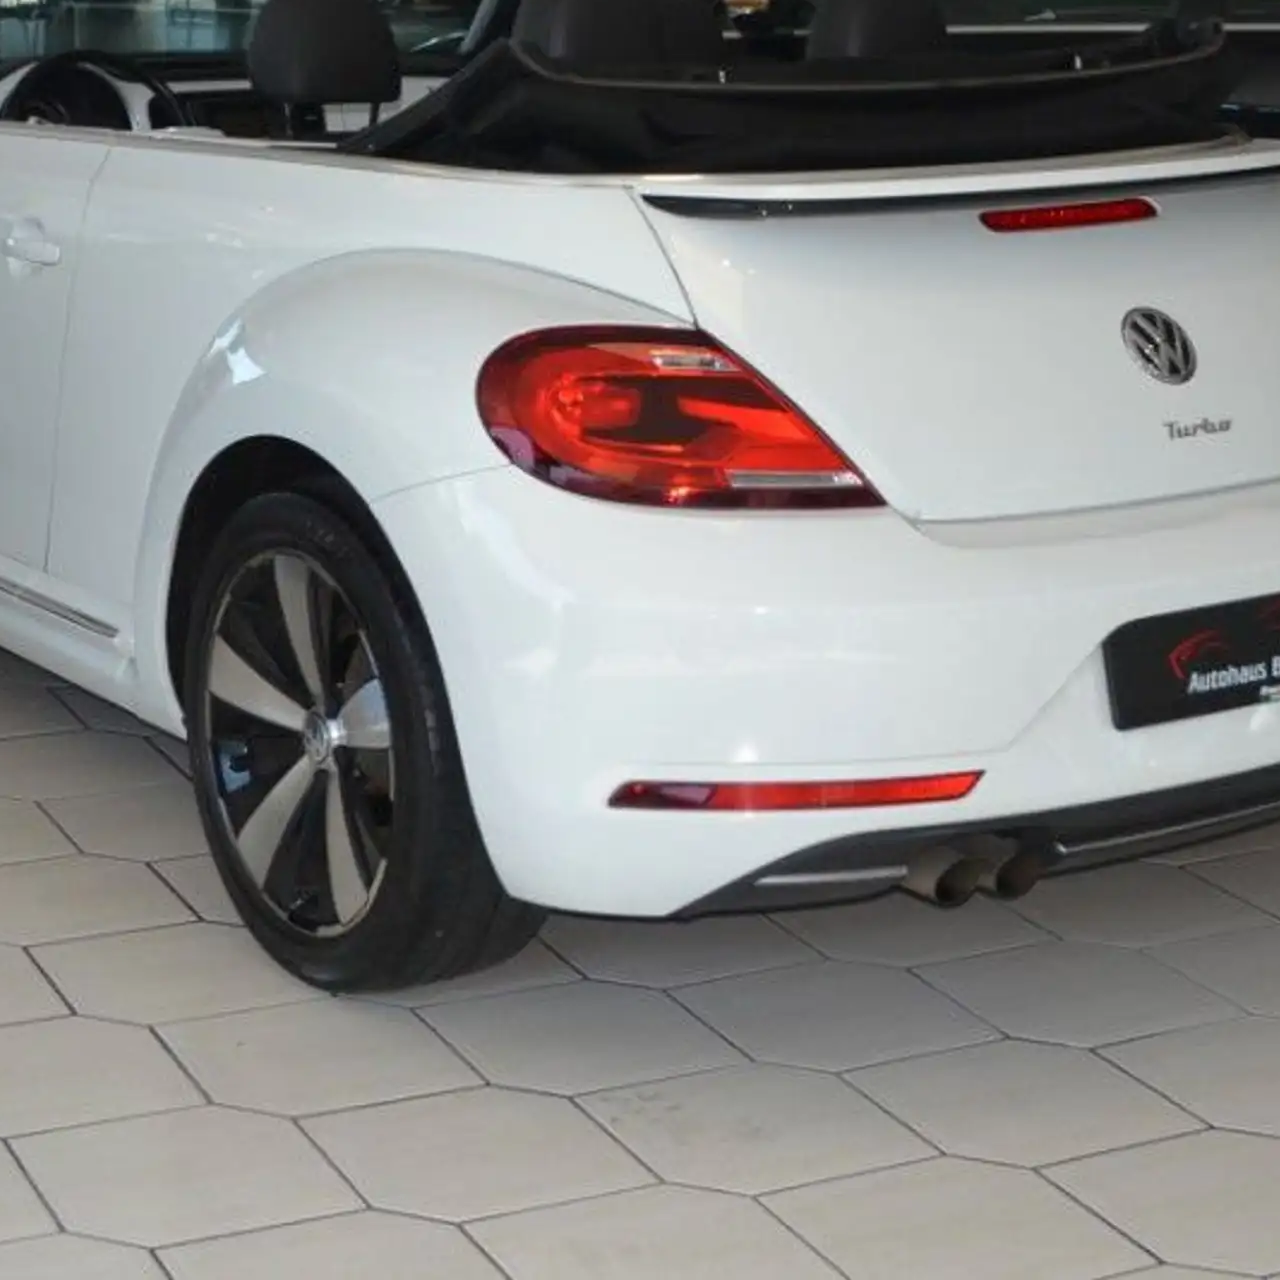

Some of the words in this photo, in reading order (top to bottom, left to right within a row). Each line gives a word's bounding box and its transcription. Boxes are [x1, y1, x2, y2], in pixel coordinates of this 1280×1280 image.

[1120, 306, 1198, 386] VW
[1163, 417, 1233, 440] Turbo
[1188, 662, 1267, 694] Autohaus
